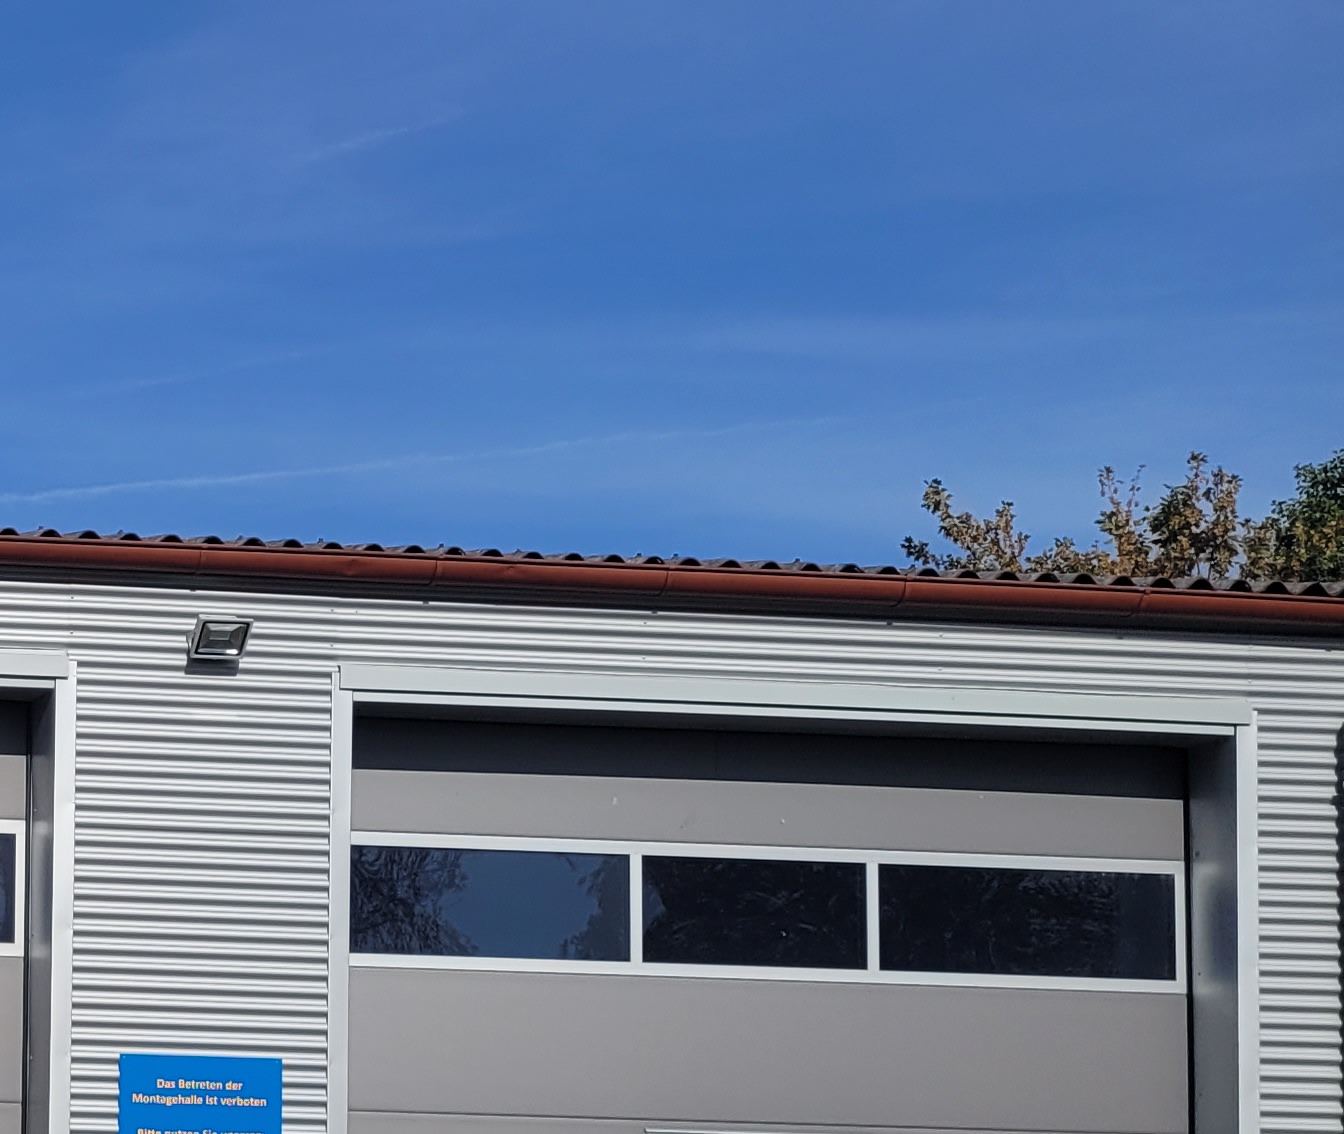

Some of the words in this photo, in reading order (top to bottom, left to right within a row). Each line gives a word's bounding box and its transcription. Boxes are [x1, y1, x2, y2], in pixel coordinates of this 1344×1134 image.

[156, 1079, 175, 1089] Das
[178, 1079, 223, 1090] Betreten
[225, 1080, 243, 1091] der
[132, 1093, 203, 1106] Montagehalle
[205, 1095, 218, 1105] ist
[220, 1096, 267, 1107] verboten
